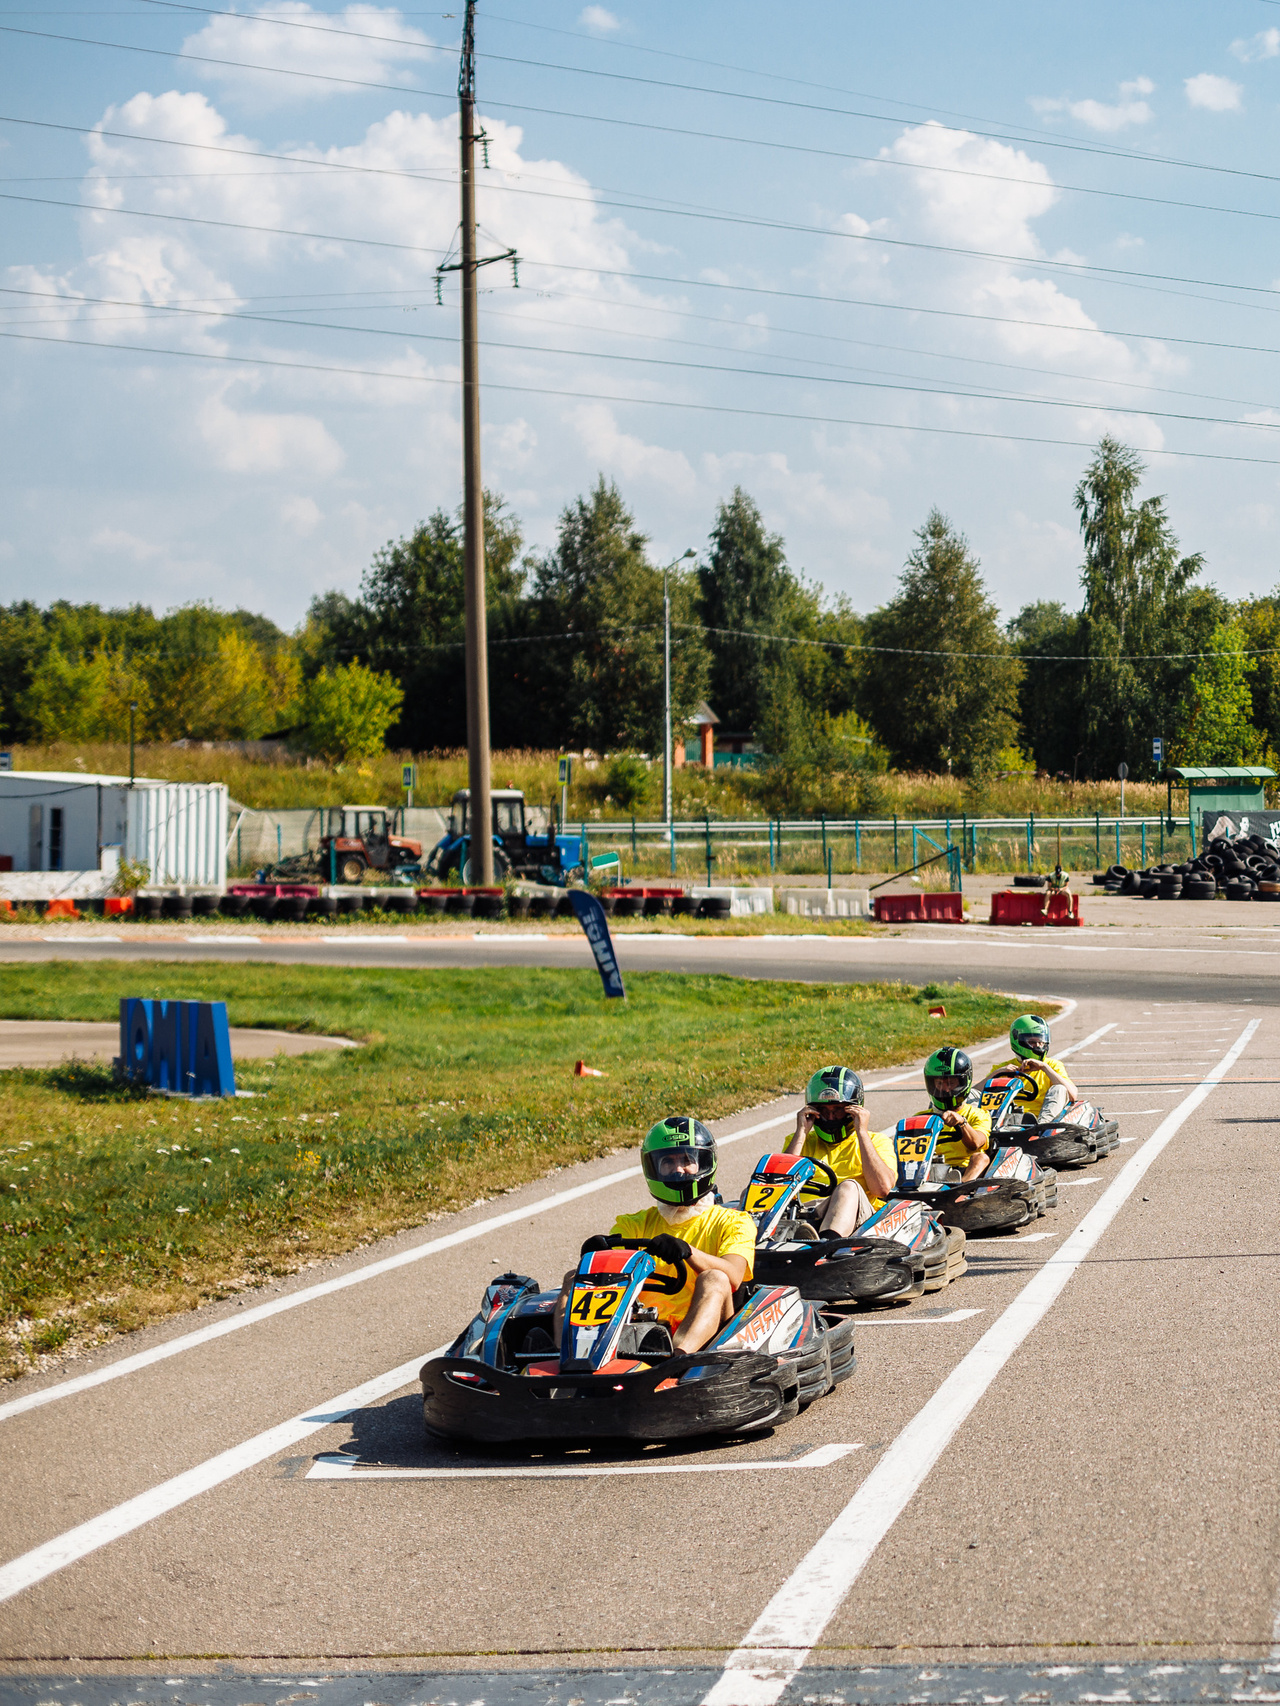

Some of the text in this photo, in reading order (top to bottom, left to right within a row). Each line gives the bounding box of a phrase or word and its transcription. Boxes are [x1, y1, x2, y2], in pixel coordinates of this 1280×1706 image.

[900, 1137, 927, 1155] 26
[753, 1187, 775, 1208] 2
[873, 1208, 908, 1237] МАЯК
[571, 1291, 618, 1320] 42
[735, 1300, 784, 1344] МАЯК
